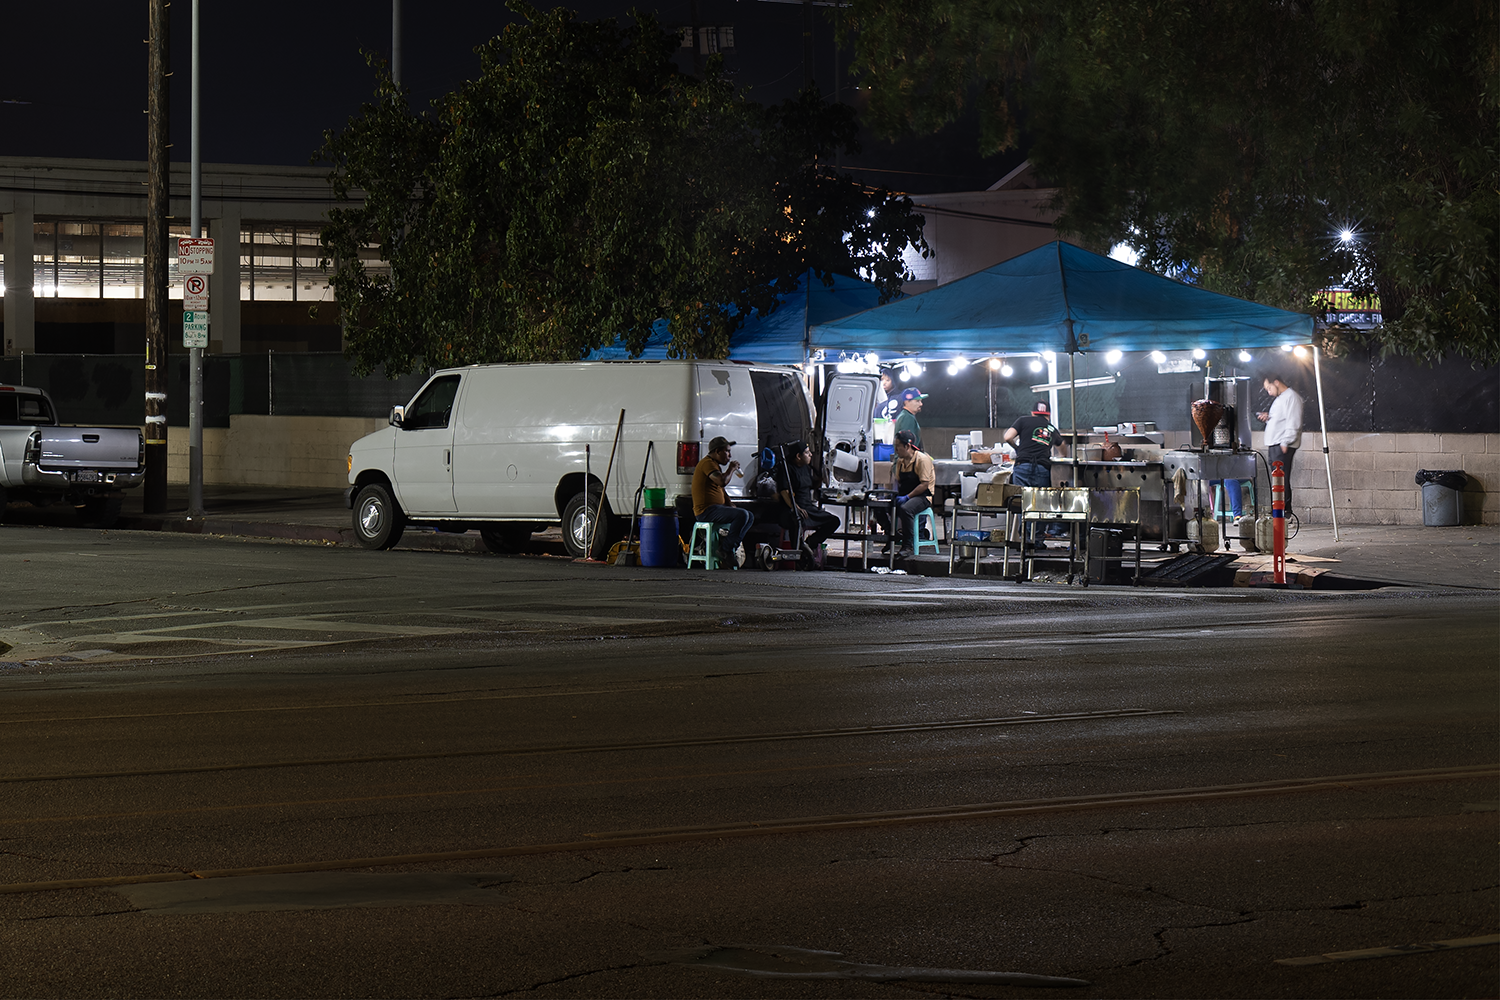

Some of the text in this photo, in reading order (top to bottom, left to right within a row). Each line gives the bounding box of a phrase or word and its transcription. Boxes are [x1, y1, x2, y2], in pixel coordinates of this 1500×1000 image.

[180, 246, 190, 256] NO
[180, 257, 194, 265] 10PM
[200, 257, 212, 265] 5AM
[186, 312, 192, 321] 2
[1338, 313, 1365, 323] CHECK
[185, 323, 207, 331] PARKING
